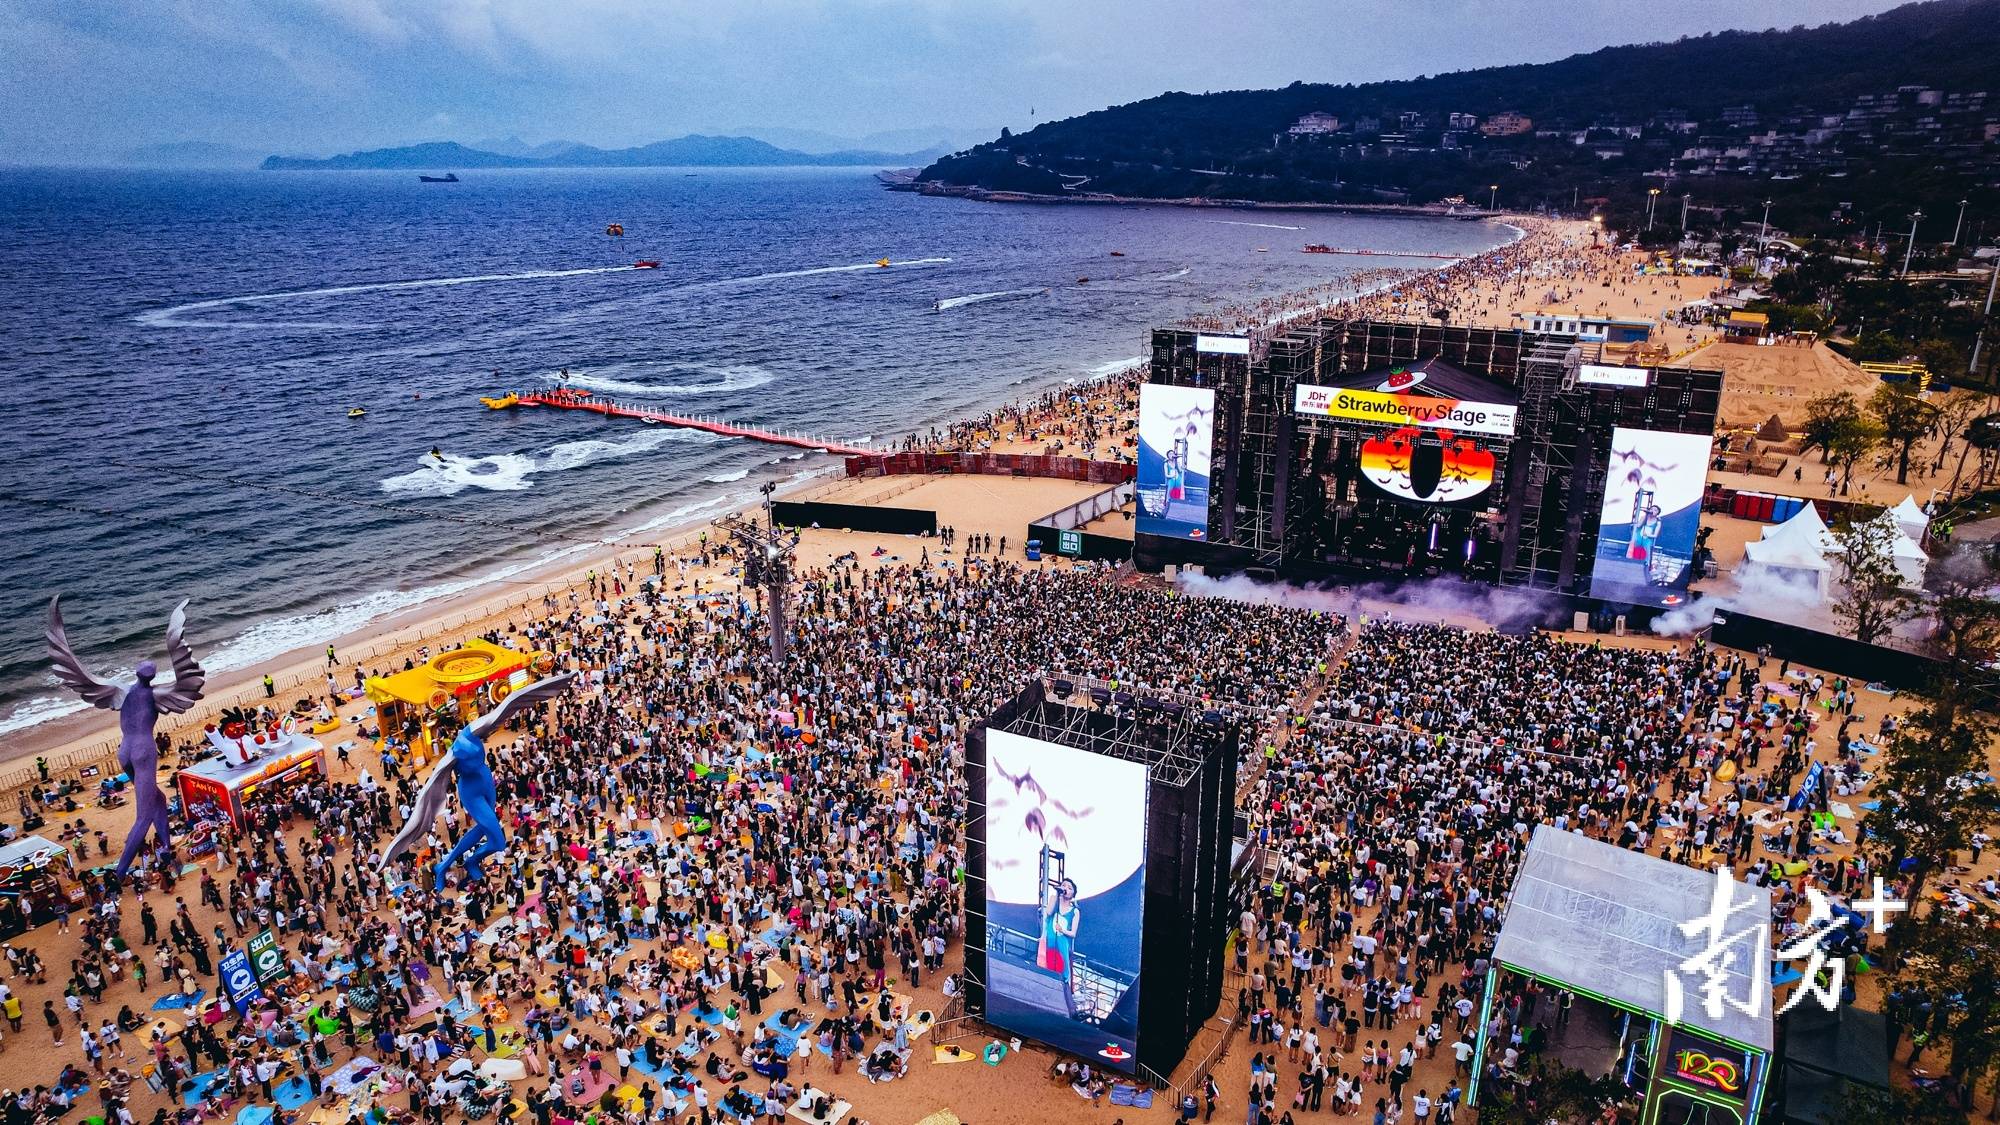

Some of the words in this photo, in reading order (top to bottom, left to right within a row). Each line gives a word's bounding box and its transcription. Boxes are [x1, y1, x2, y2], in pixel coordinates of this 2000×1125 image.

[1338, 394, 1432, 422] Strawberry
[1435, 404, 1486, 426] Stage
[1062, 541, 1077, 551] 出口
[251, 931, 274, 953] 出口
[221, 951, 245, 971] 卫生间
[227, 961, 244, 973] TOILET
